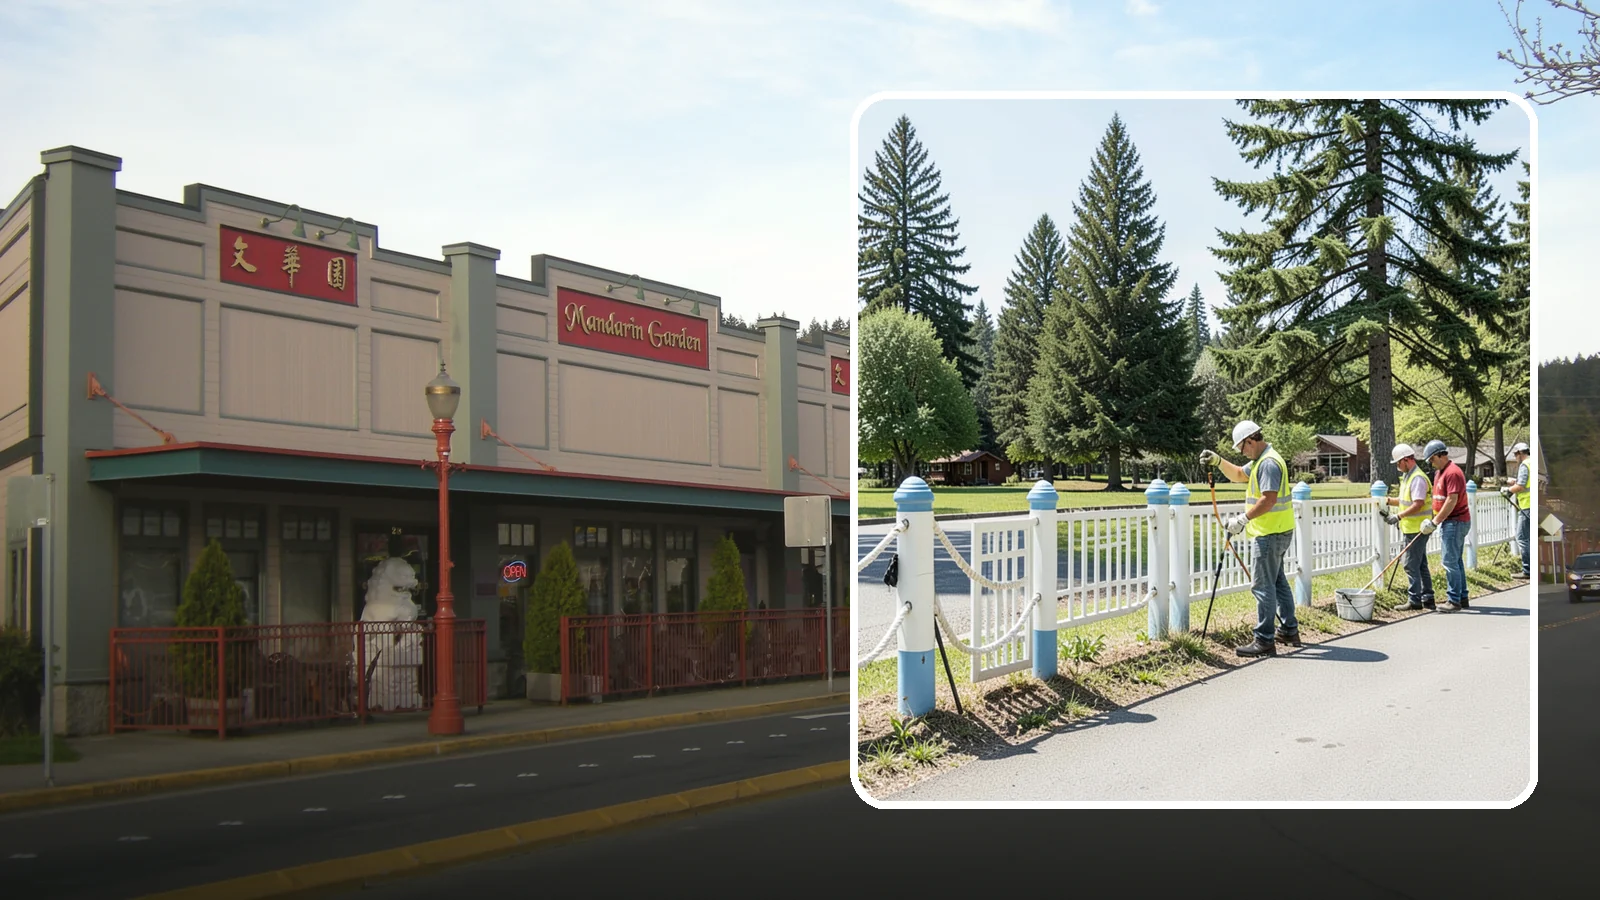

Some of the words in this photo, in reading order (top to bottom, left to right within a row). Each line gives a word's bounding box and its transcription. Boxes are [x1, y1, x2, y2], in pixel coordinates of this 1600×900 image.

[231, 236, 346, 291] 文華園
[564, 302, 644, 341] Mandarin
[648, 320, 701, 352] Garden
[835, 363, 846, 386] 文
[503, 565, 526, 578] OPEN
